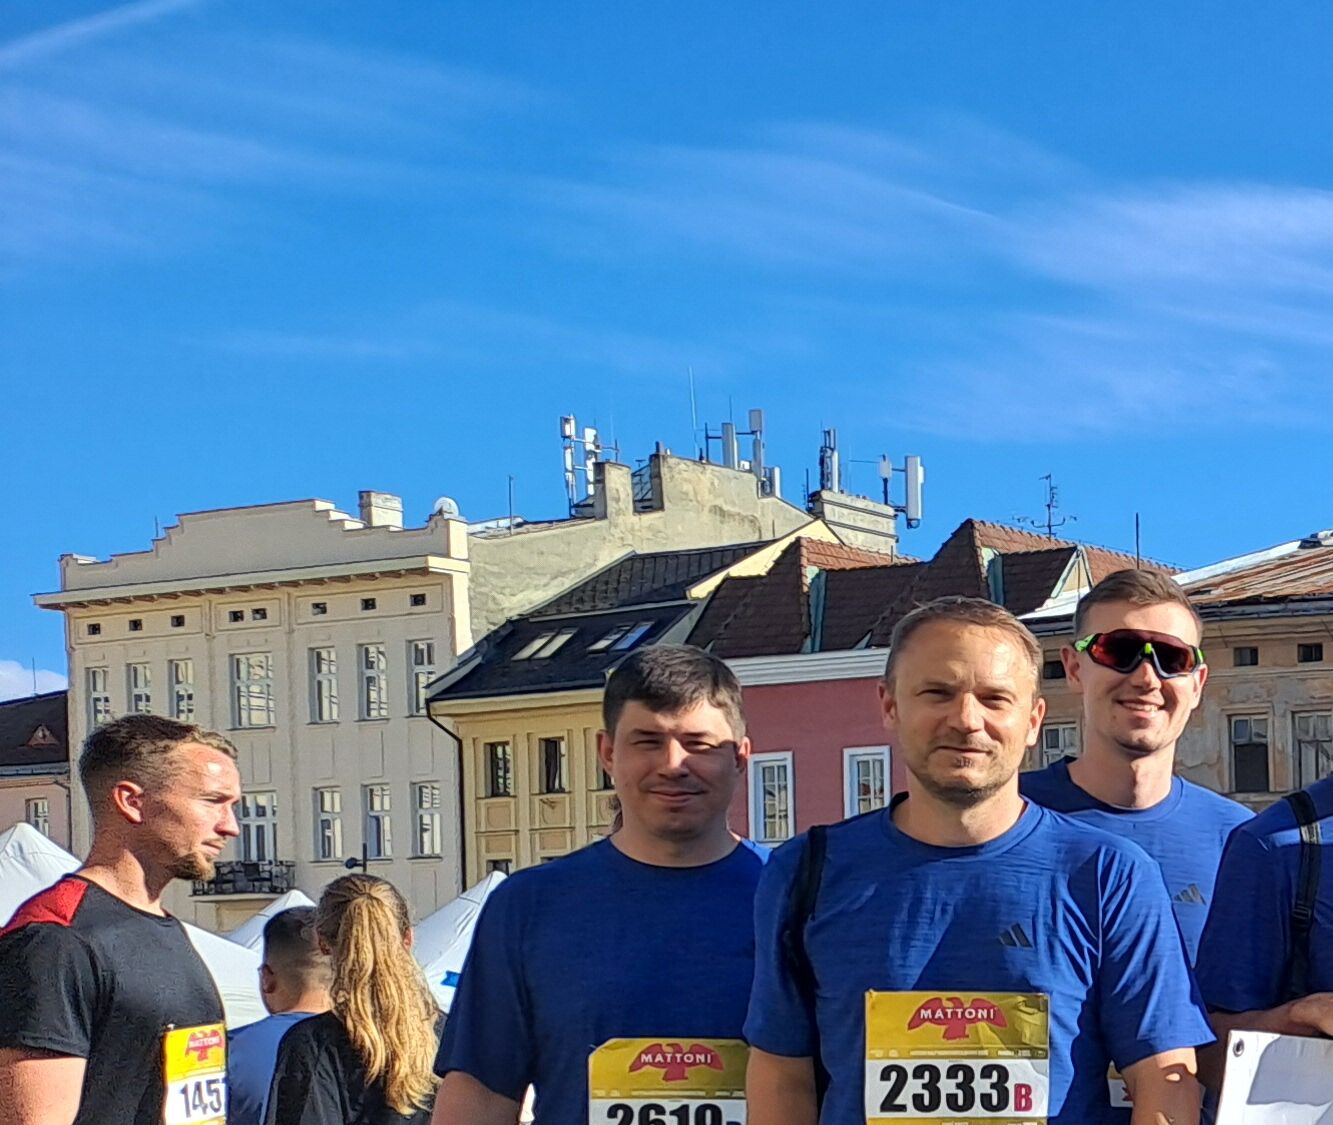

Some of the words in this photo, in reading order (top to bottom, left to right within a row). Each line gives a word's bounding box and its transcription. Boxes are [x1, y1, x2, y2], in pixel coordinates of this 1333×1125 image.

[919, 1007, 995, 1020] MATTONI
[640, 1051, 713, 1065] MATTONI
[180, 1077, 226, 1118] 145
